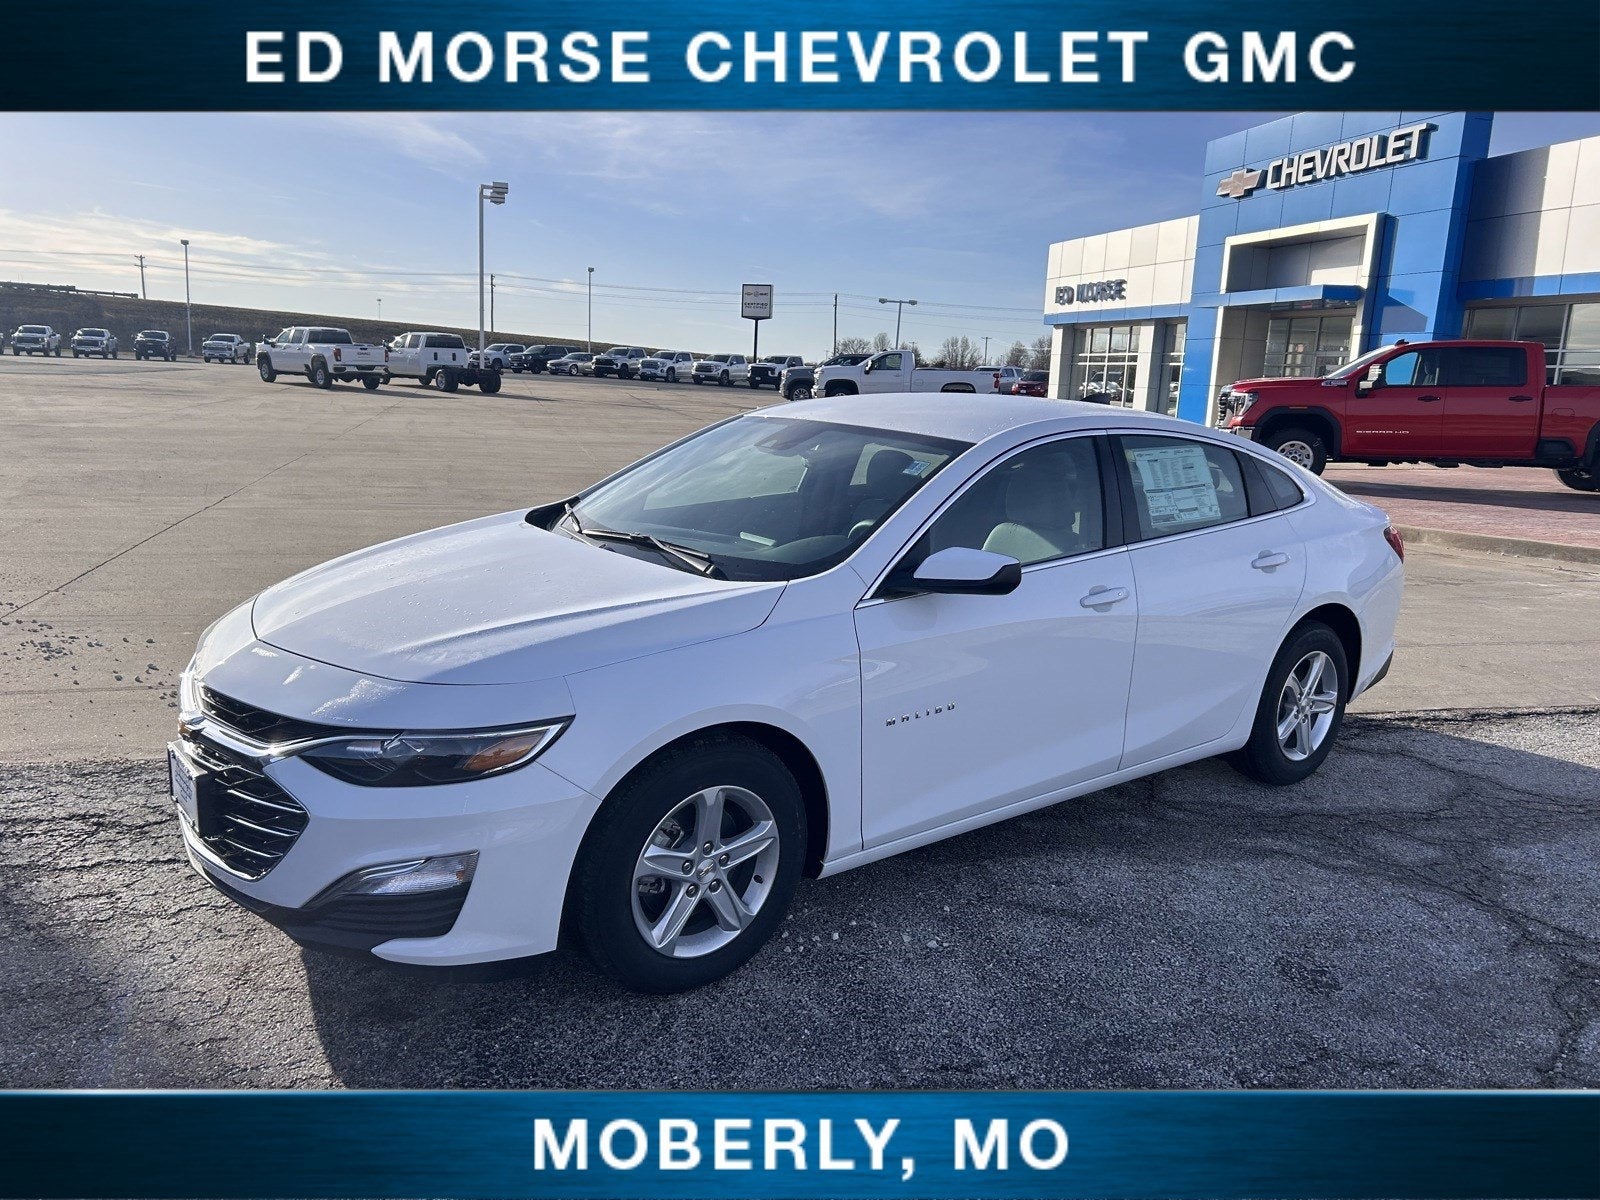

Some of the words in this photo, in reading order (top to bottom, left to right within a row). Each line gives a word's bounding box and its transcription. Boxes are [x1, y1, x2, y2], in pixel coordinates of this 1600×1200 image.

[1266, 122, 1439, 191] CHEVROLET
[1055, 286, 1075, 306] ED
[1076, 279, 1128, 304] MORSE
[885, 702, 956, 727] MALIBU
